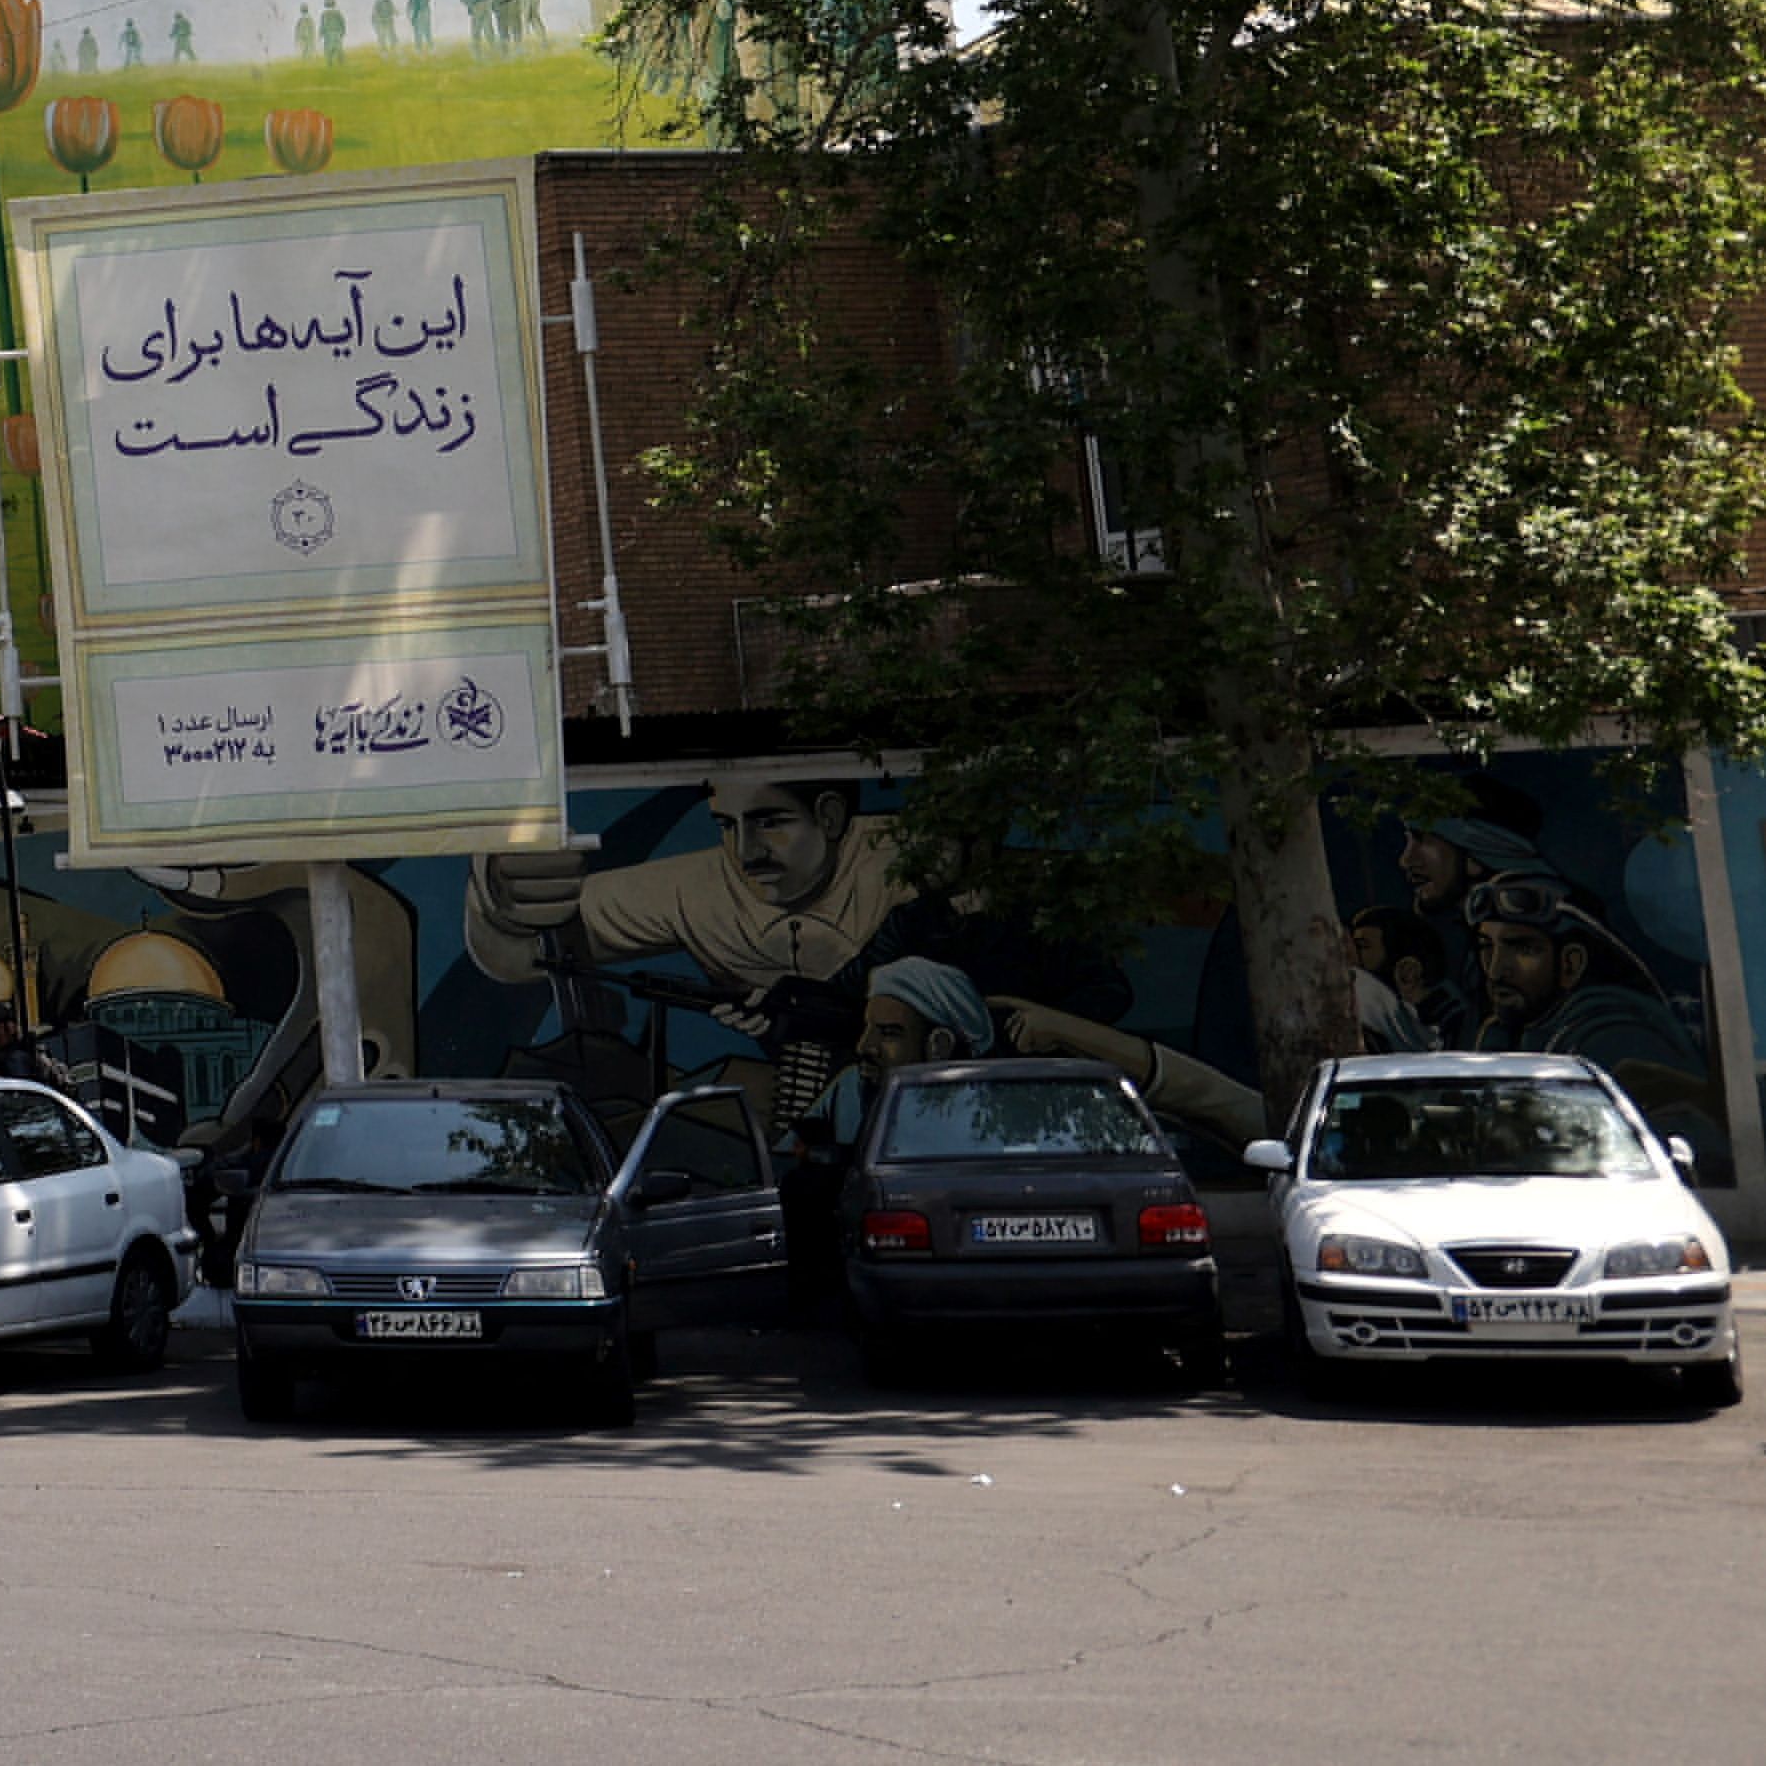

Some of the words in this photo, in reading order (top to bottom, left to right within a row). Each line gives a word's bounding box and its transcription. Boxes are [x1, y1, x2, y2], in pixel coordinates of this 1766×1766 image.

[101, 297, 225, 385] برای
[373, 273, 467, 357] این
[115, 382, 279, 457] است
[287, 370, 476, 457] زندگی
[171, 712, 213, 733] عدد
[214, 704, 272, 733] ارسال
